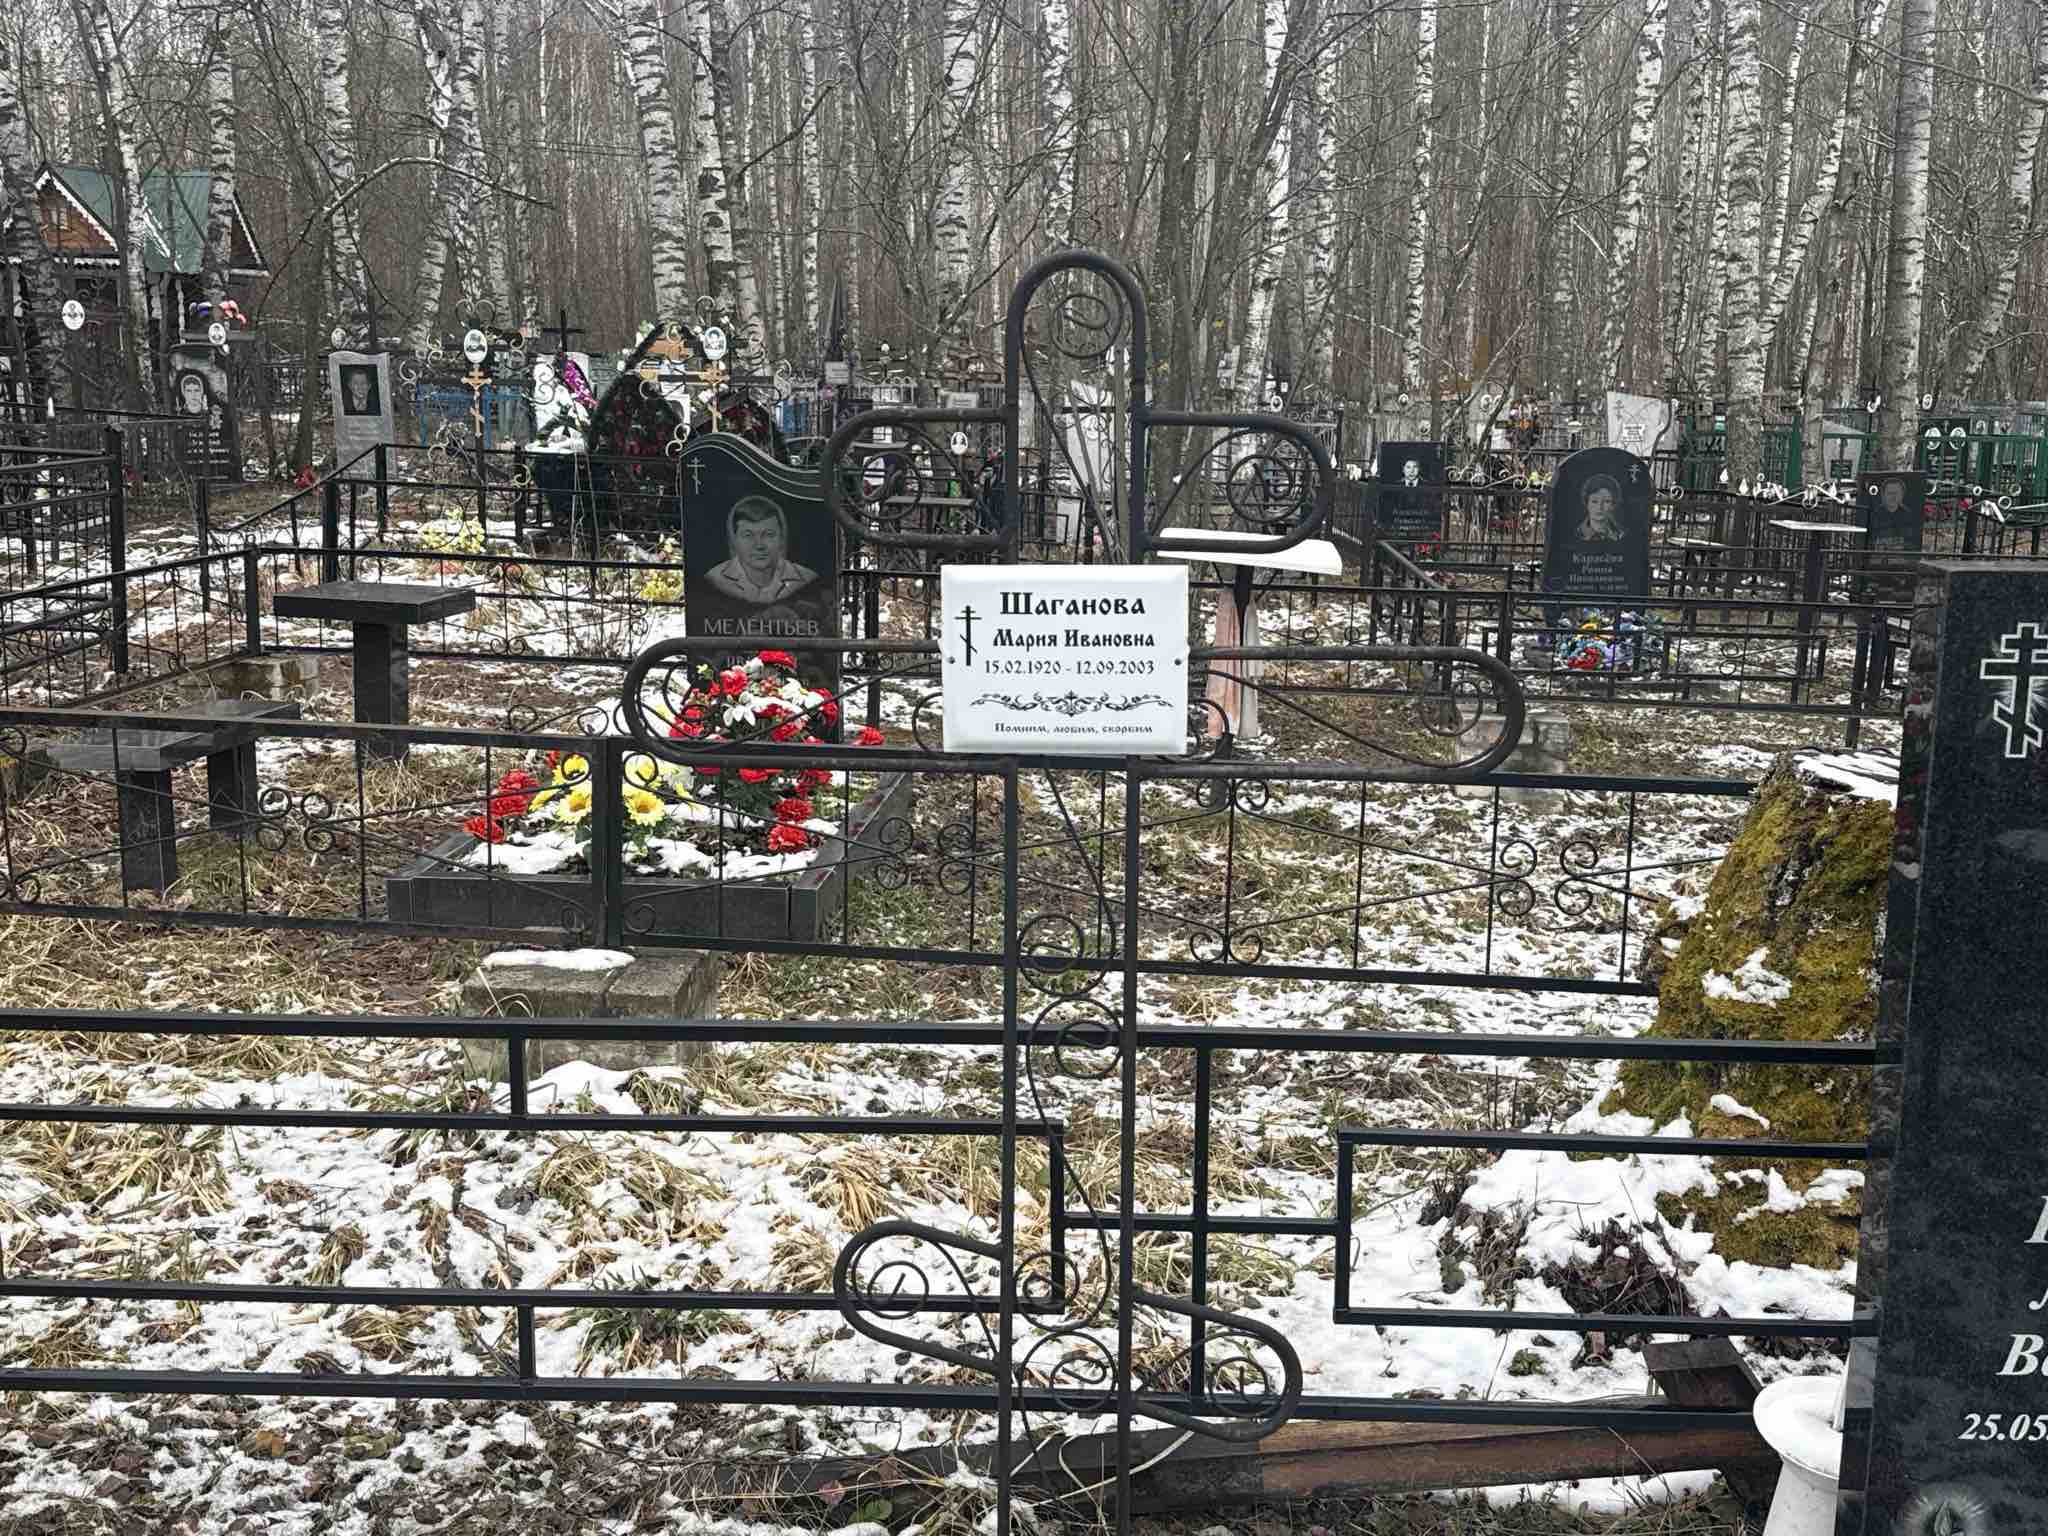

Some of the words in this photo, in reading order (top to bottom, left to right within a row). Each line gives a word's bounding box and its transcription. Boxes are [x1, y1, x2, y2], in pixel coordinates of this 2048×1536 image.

[1000, 591, 1146, 616] Шаганова
[703, 617, 819, 637] МЕЛЕНТЬЕВ
[992, 629, 1058, 652] Мария
[1064, 629, 1155, 648] Ивановна
[985, 660, 1061, 675] 15.02.1920
[1075, 660, 1155, 675] 12.09.2003
[994, 723, 1050, 733] Помним,
[1053, 724, 1099, 734] любим,
[1102, 724, 1154, 735] скорбим
